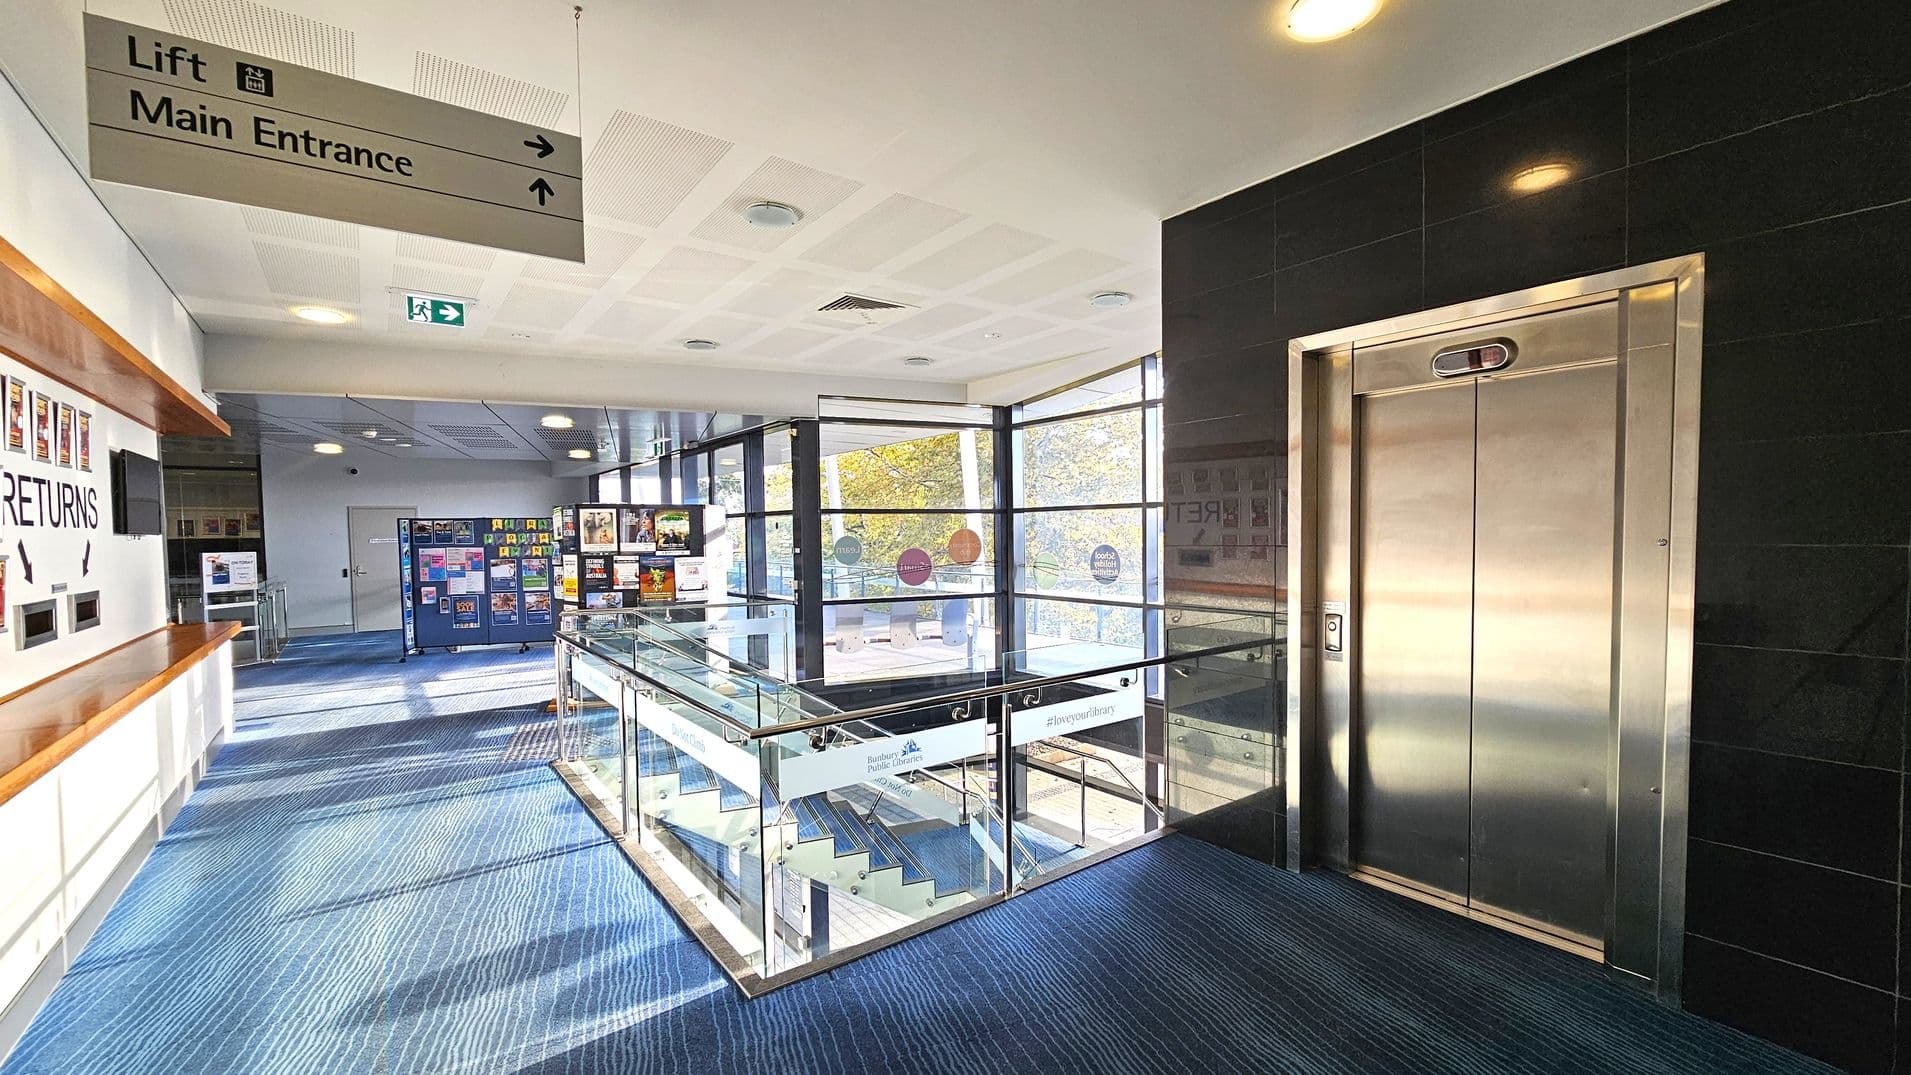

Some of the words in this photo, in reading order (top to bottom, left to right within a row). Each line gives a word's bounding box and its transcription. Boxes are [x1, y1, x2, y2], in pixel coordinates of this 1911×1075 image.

[128, 35, 207, 83] Lift
[130, 89, 233, 139] Main
[253, 116, 413, 177] Entrance
[3, 472, 98, 529] RETURNS
[1047, 705, 1116, 727] #loveyourlibrary
[867, 751, 899, 764] Bunbury
[867, 761, 890, 773] Public
[892, 755, 924, 768] Libraries
